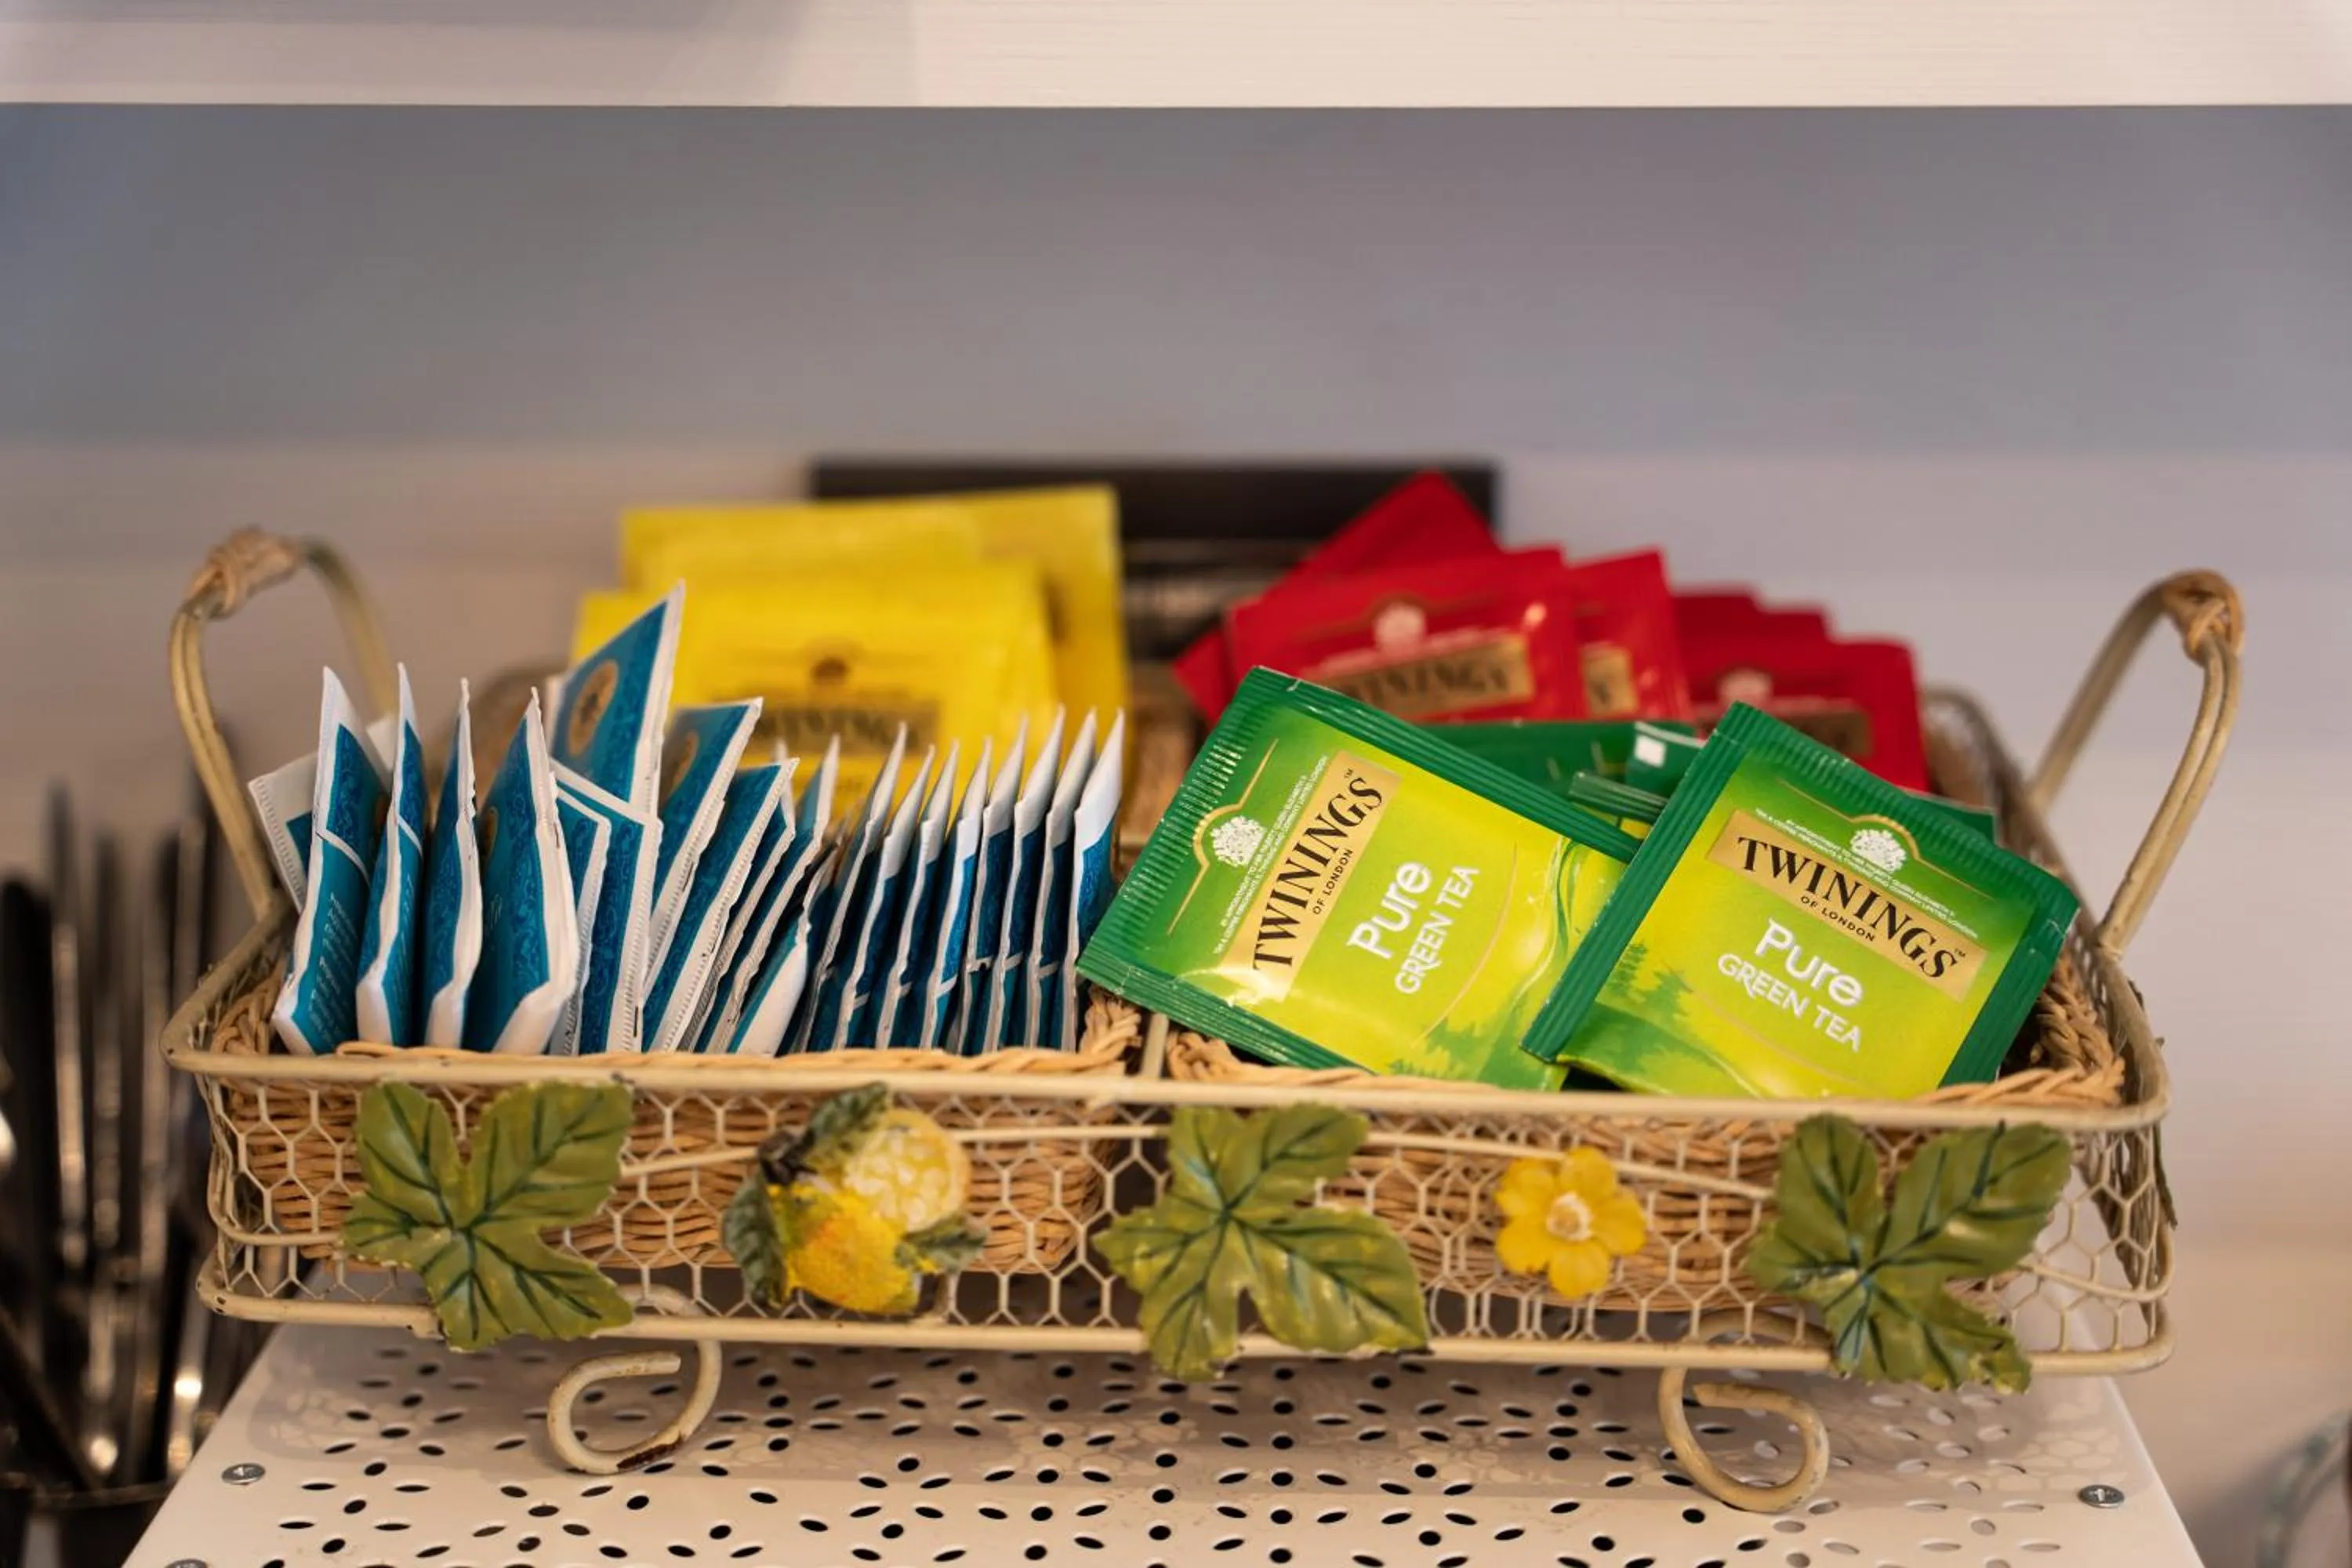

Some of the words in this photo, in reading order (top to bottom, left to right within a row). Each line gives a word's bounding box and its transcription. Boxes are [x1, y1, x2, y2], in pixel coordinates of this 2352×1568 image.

[1253, 777, 1382, 970] TWININGS
[1312, 898, 1326, 914] OF
[1325, 849, 1353, 896] LONDON
[1346, 862, 1432, 959] Pure
[1737, 837, 1958, 978] TWININGS
[1800, 895, 1817, 908] OF
[1821, 907, 1876, 942] LONDON
[1395, 910, 1454, 993] GREEN
[1435, 866, 1480, 908] TEA
[1755, 918, 1864, 1006] Pure
[1718, 953, 1809, 1018] GREEN
[1813, 1005, 1862, 1053] TEA
